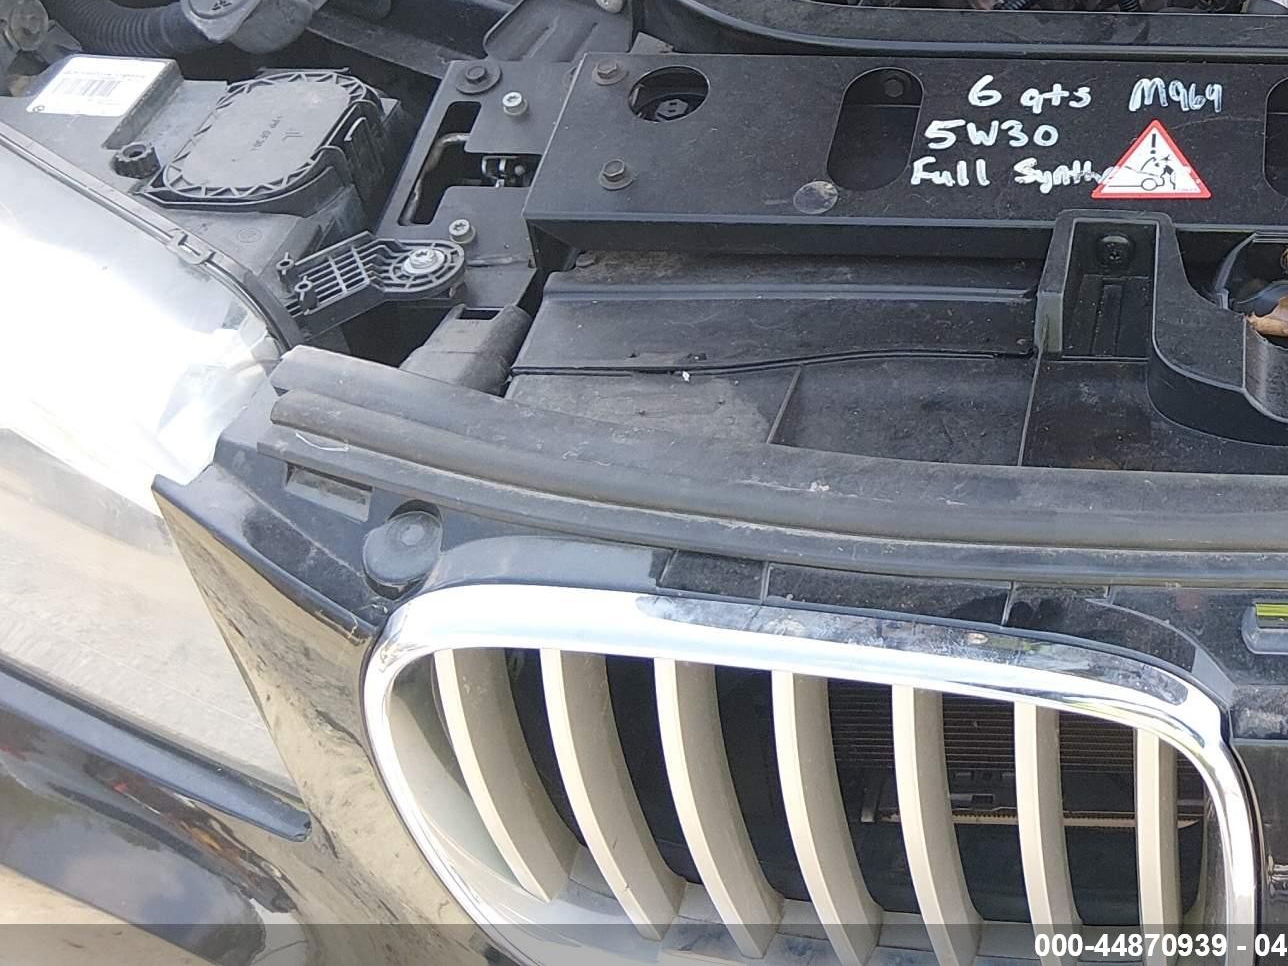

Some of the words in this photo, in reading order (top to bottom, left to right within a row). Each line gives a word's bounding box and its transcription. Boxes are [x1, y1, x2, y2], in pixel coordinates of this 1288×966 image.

[968, 74, 1002, 107] 6
[1020, 83, 1092, 114] qts
[924, 119, 1059, 150] 5W30
[910, 156, 991, 187] Full
